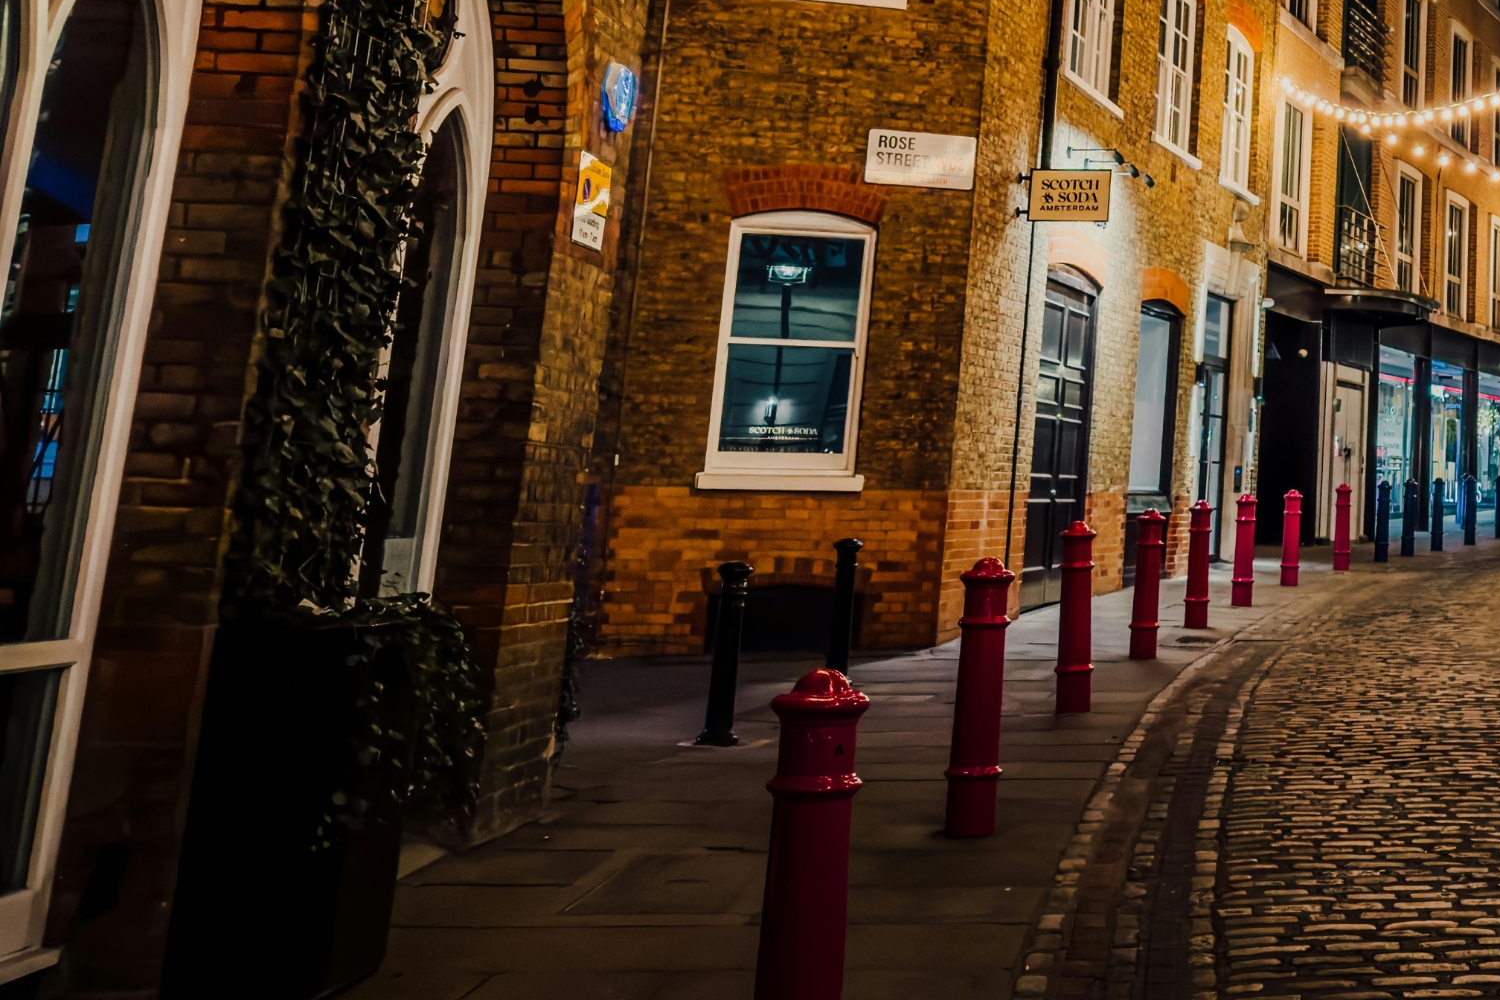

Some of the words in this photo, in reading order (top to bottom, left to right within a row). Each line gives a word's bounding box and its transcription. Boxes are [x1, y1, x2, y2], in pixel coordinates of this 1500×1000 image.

[878, 135, 916, 150] ROSE
[876, 151, 930, 168] STREET
[1041, 178, 1100, 191] SCOTCH
[1040, 191, 1054, 204] &
[1058, 191, 1098, 203] SODA
[748, 426, 785, 435] SCOTCH
[793, 427, 818, 435] SODA
